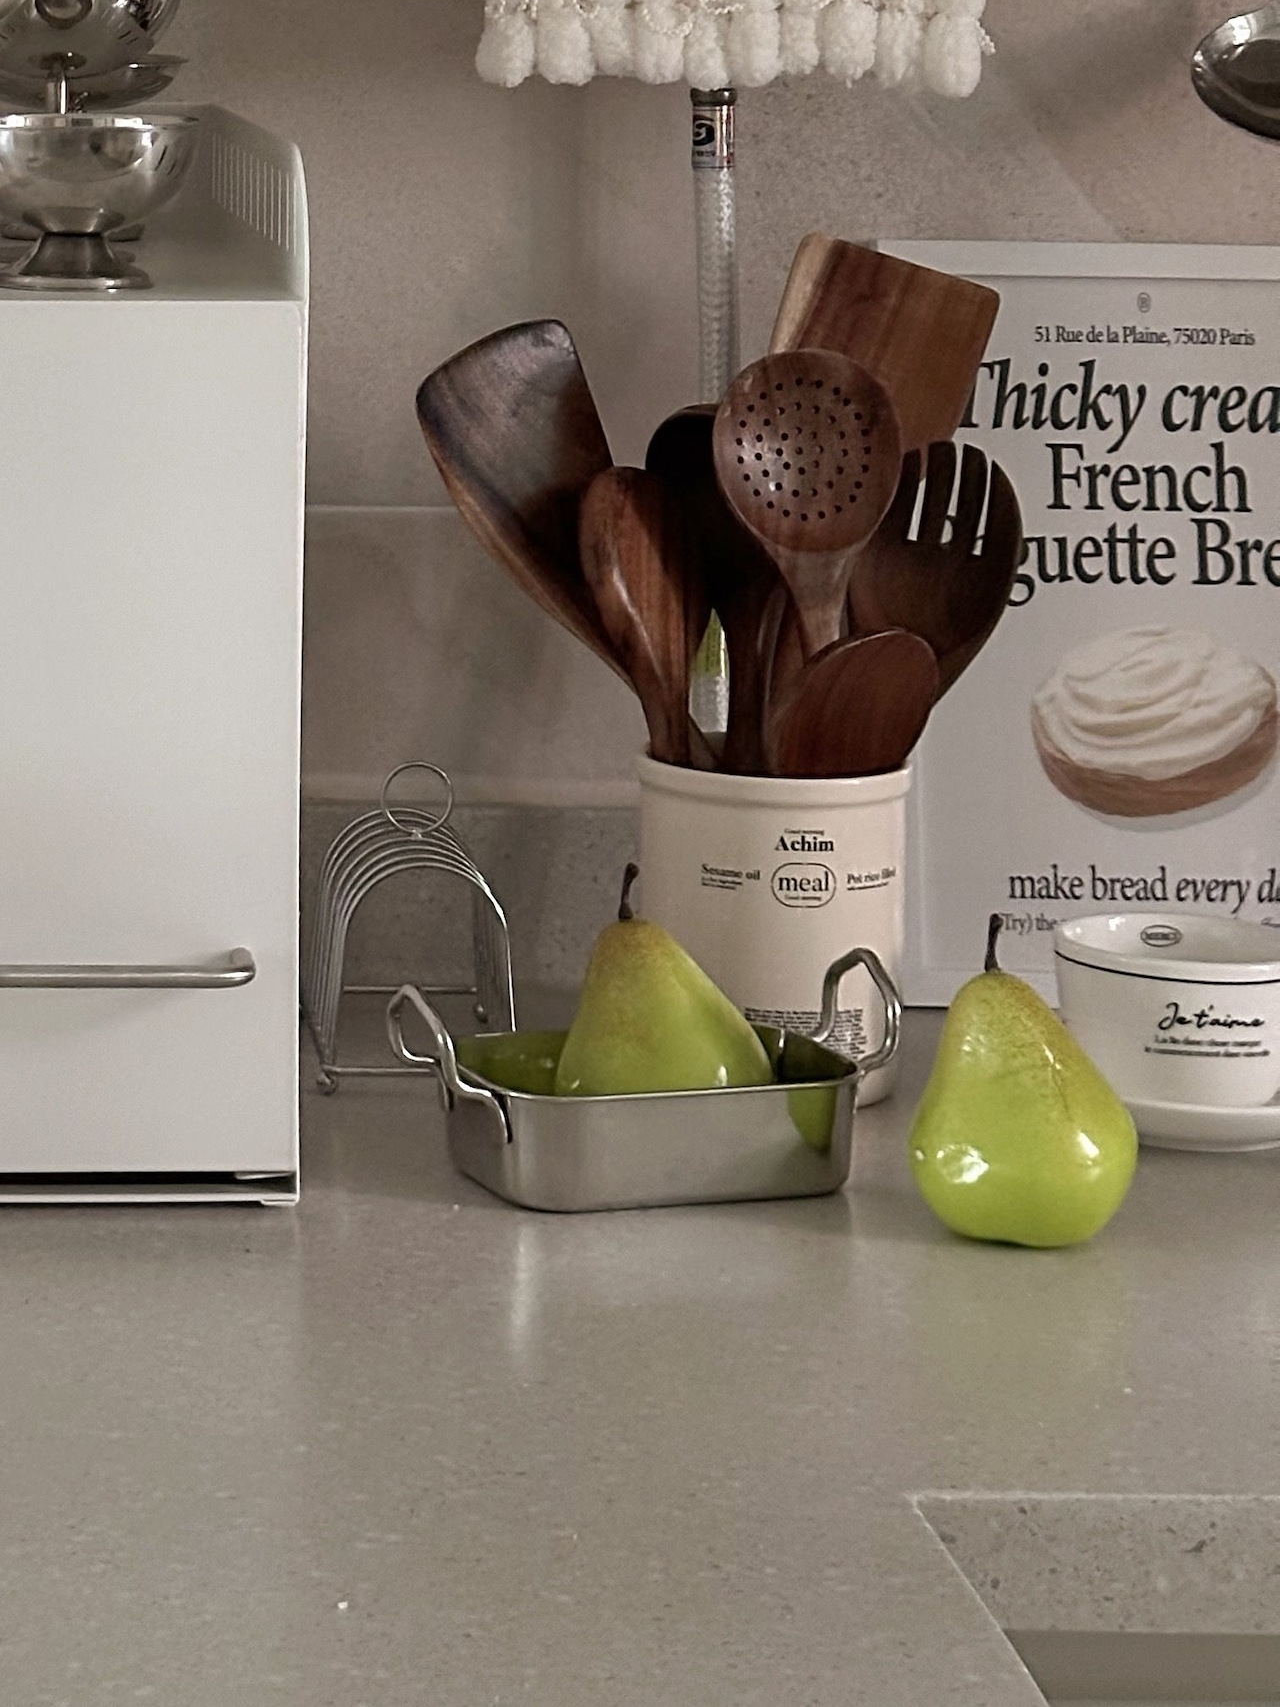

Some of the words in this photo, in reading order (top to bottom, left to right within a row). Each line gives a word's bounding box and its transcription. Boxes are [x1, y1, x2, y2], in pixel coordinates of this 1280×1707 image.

[1034, 326, 1051, 343] 51
[1055, 326, 1083, 343] Rue
[1085, 326, 1104, 343] de
[1106, 326, 1119, 343] la
[1122, 326, 1170, 346] Plaine,
[1173, 328, 1217, 345] 75020
[1219, 328, 1256, 345] Paris
[1045, 441, 1253, 513] French
[774, 835, 835, 852] Achim
[701, 863, 743, 878] Sesame
[745, 869, 761, 880] oil
[778, 870, 830, 892] meal
[1008, 863, 1084, 900] make
[1088, 864, 1169, 901] bread
[1175, 878, 1251, 914] every
[1158, 1002, 1193, 1031] Je
